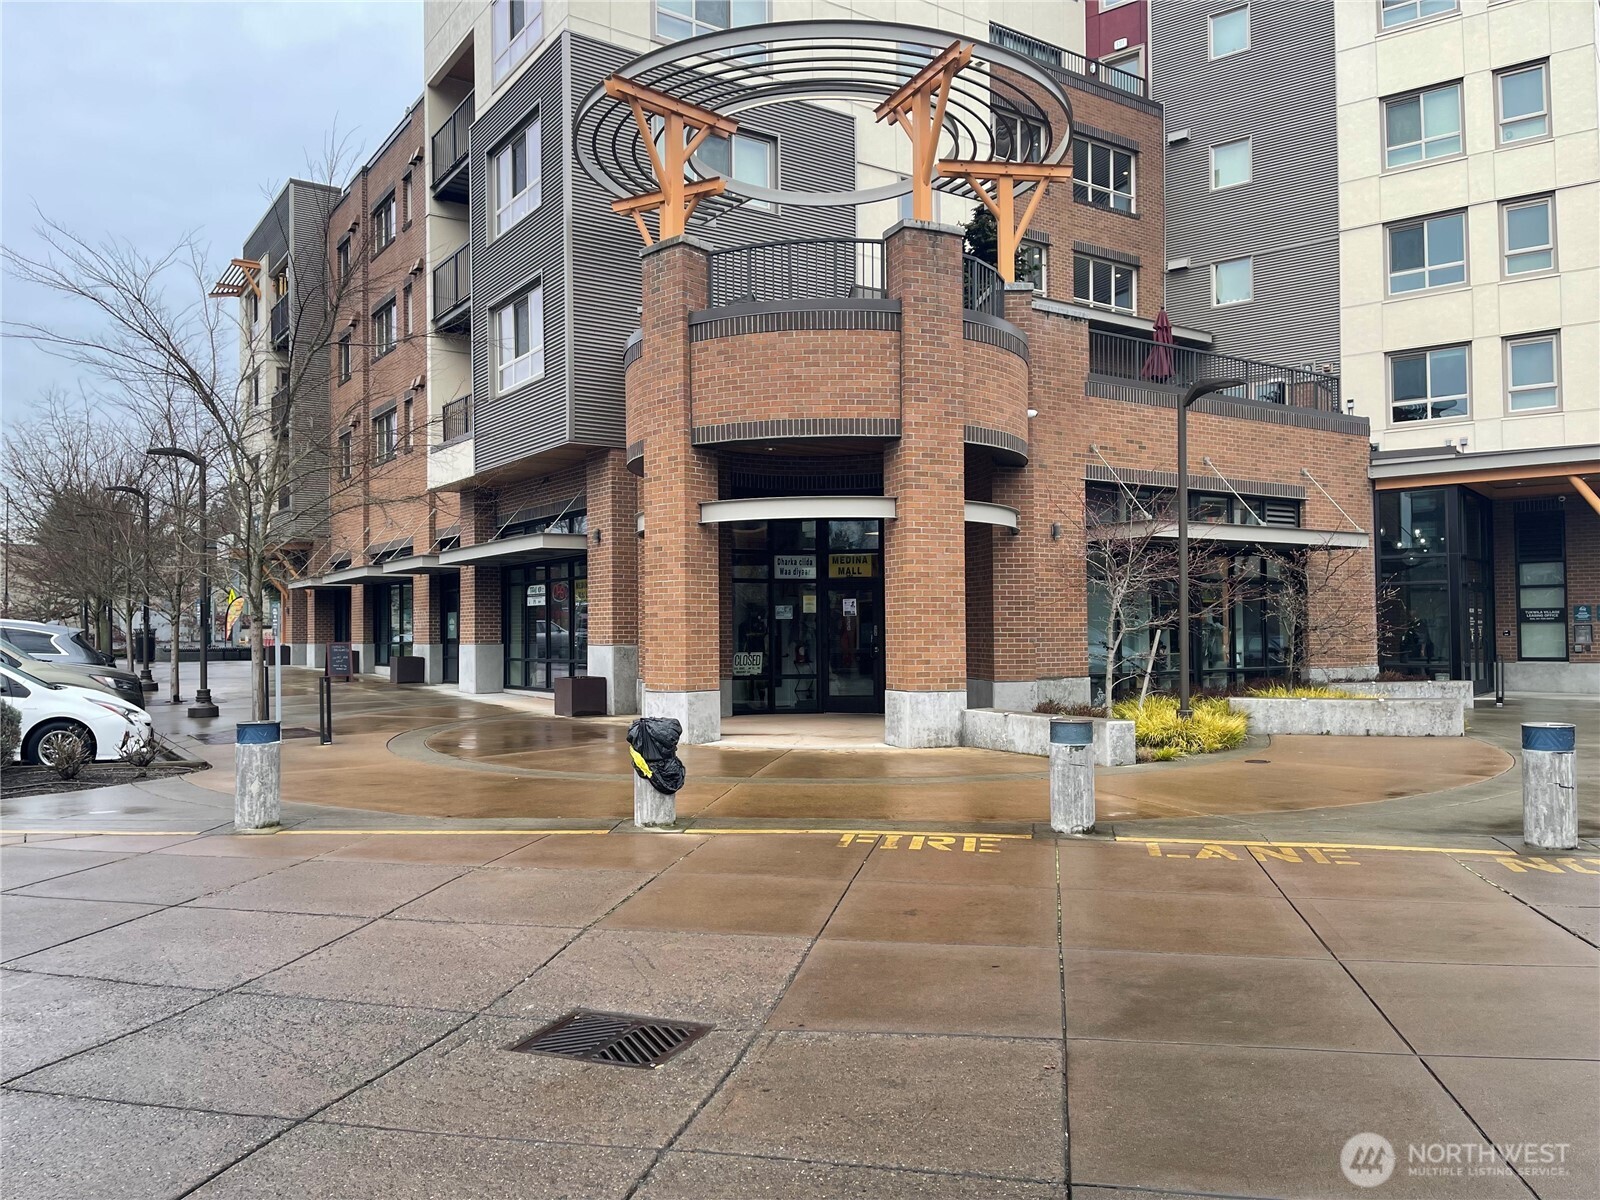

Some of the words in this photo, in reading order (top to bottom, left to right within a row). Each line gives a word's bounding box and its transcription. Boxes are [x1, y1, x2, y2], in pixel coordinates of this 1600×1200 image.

[832, 556, 868, 565] MEDINA
[838, 567, 862, 576] MALL
[734, 654, 761, 667] CLOSED
[836, 833, 1002, 853] FIRE
[1145, 842, 1362, 866] LANE
